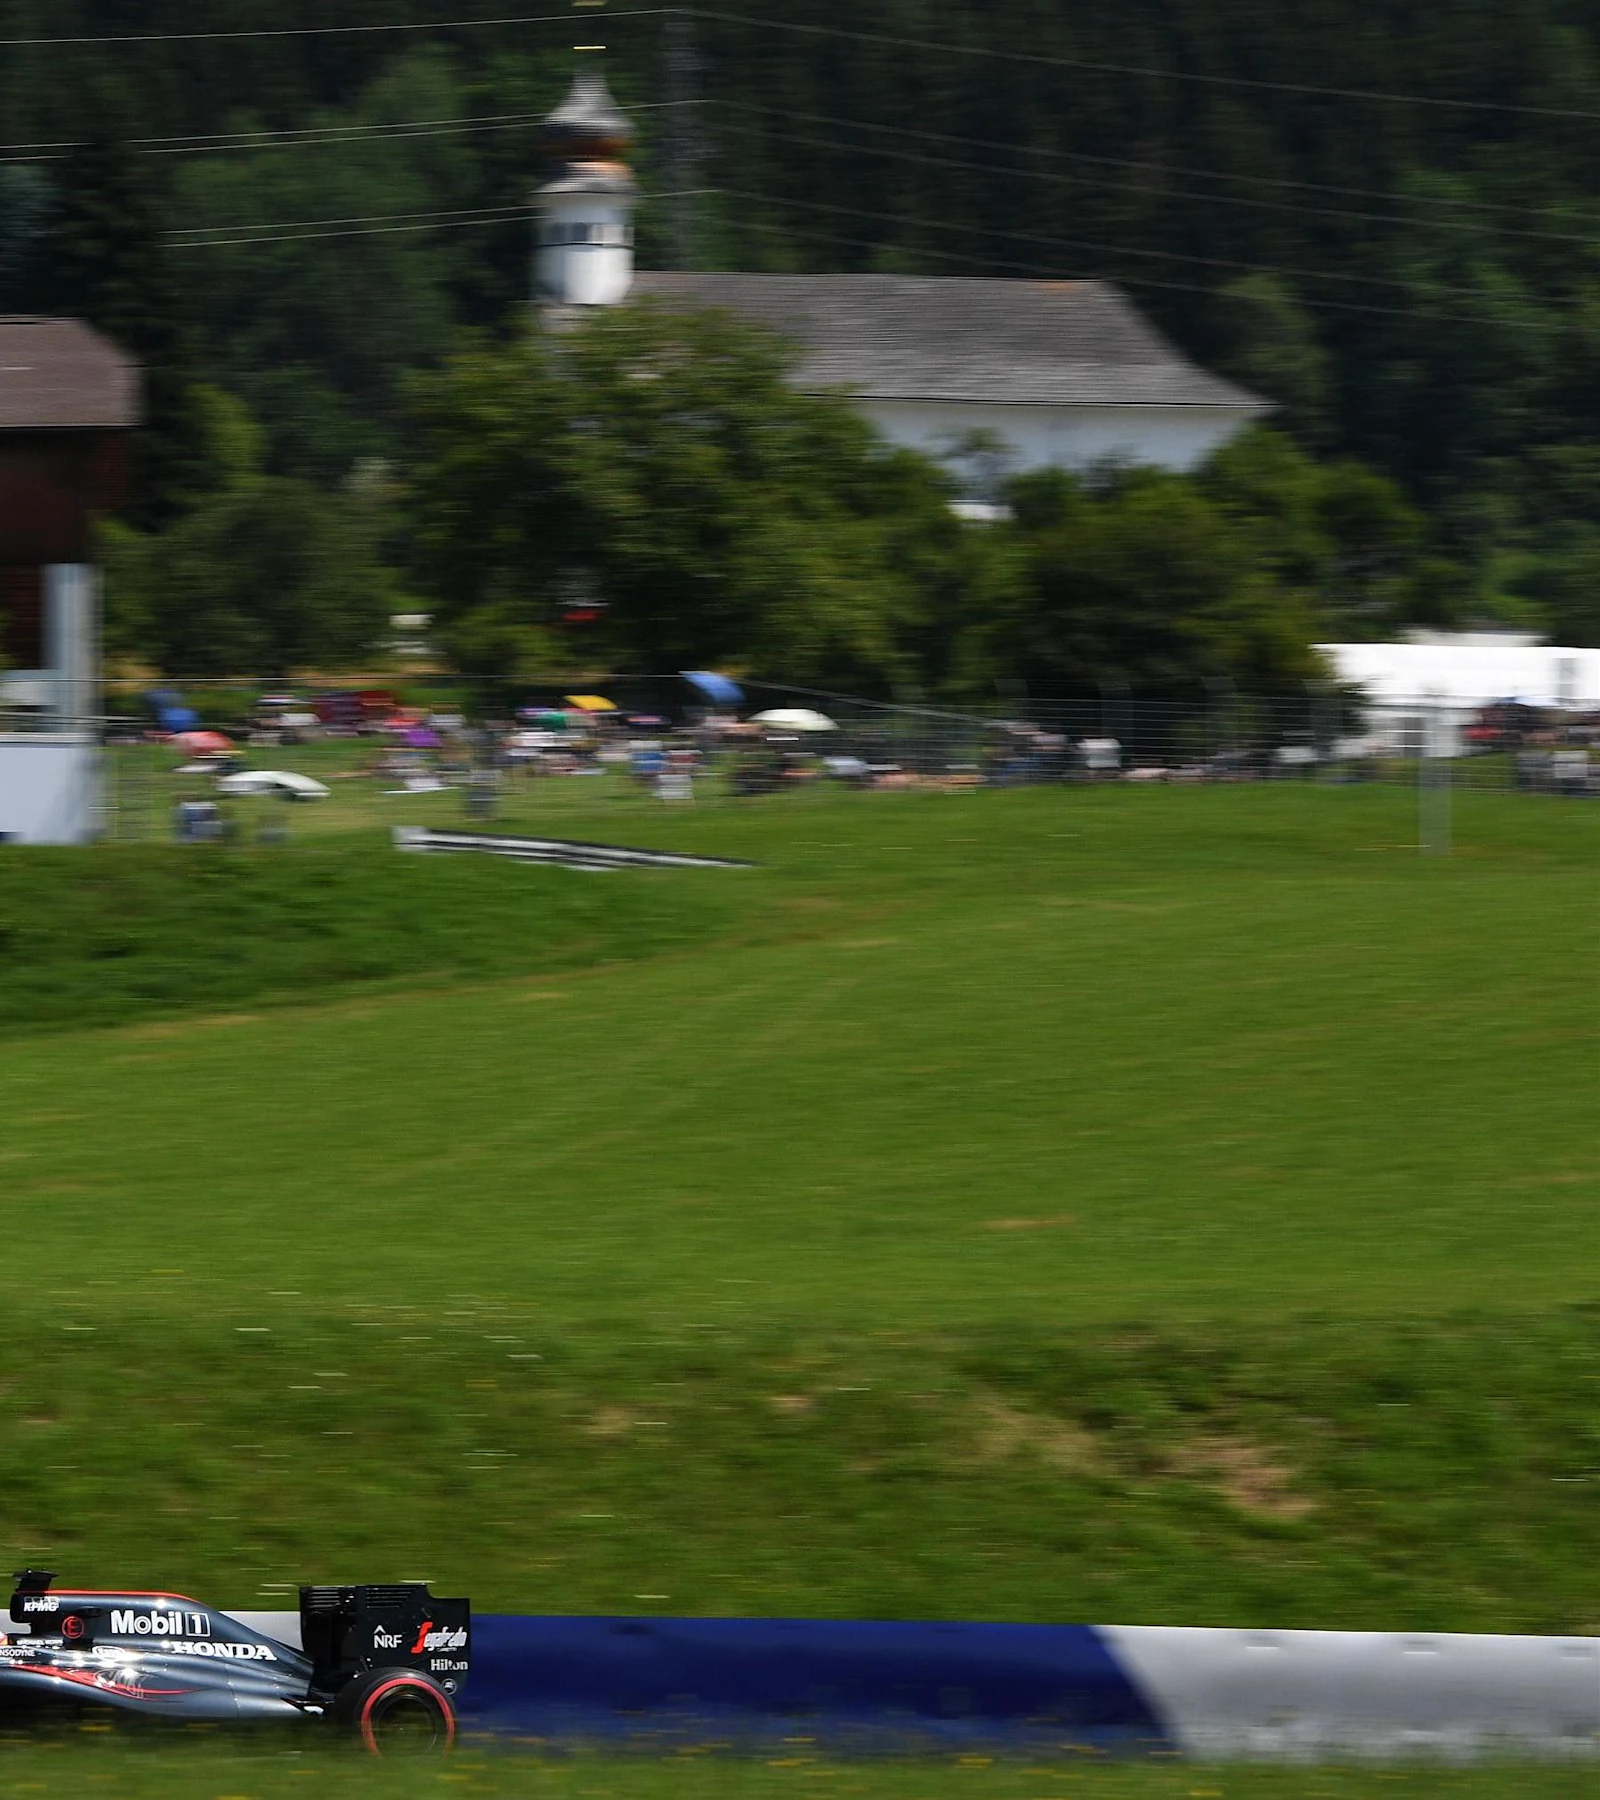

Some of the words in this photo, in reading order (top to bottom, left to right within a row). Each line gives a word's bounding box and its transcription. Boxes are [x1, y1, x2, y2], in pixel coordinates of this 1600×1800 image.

[24, 1599, 59, 1612] KPMG
[110, 1609, 183, 1635] Mobil
[374, 1634, 402, 1648] NRF
[171, 1640, 278, 1661] HONDA
[430, 1658, 469, 1671] Hilton
